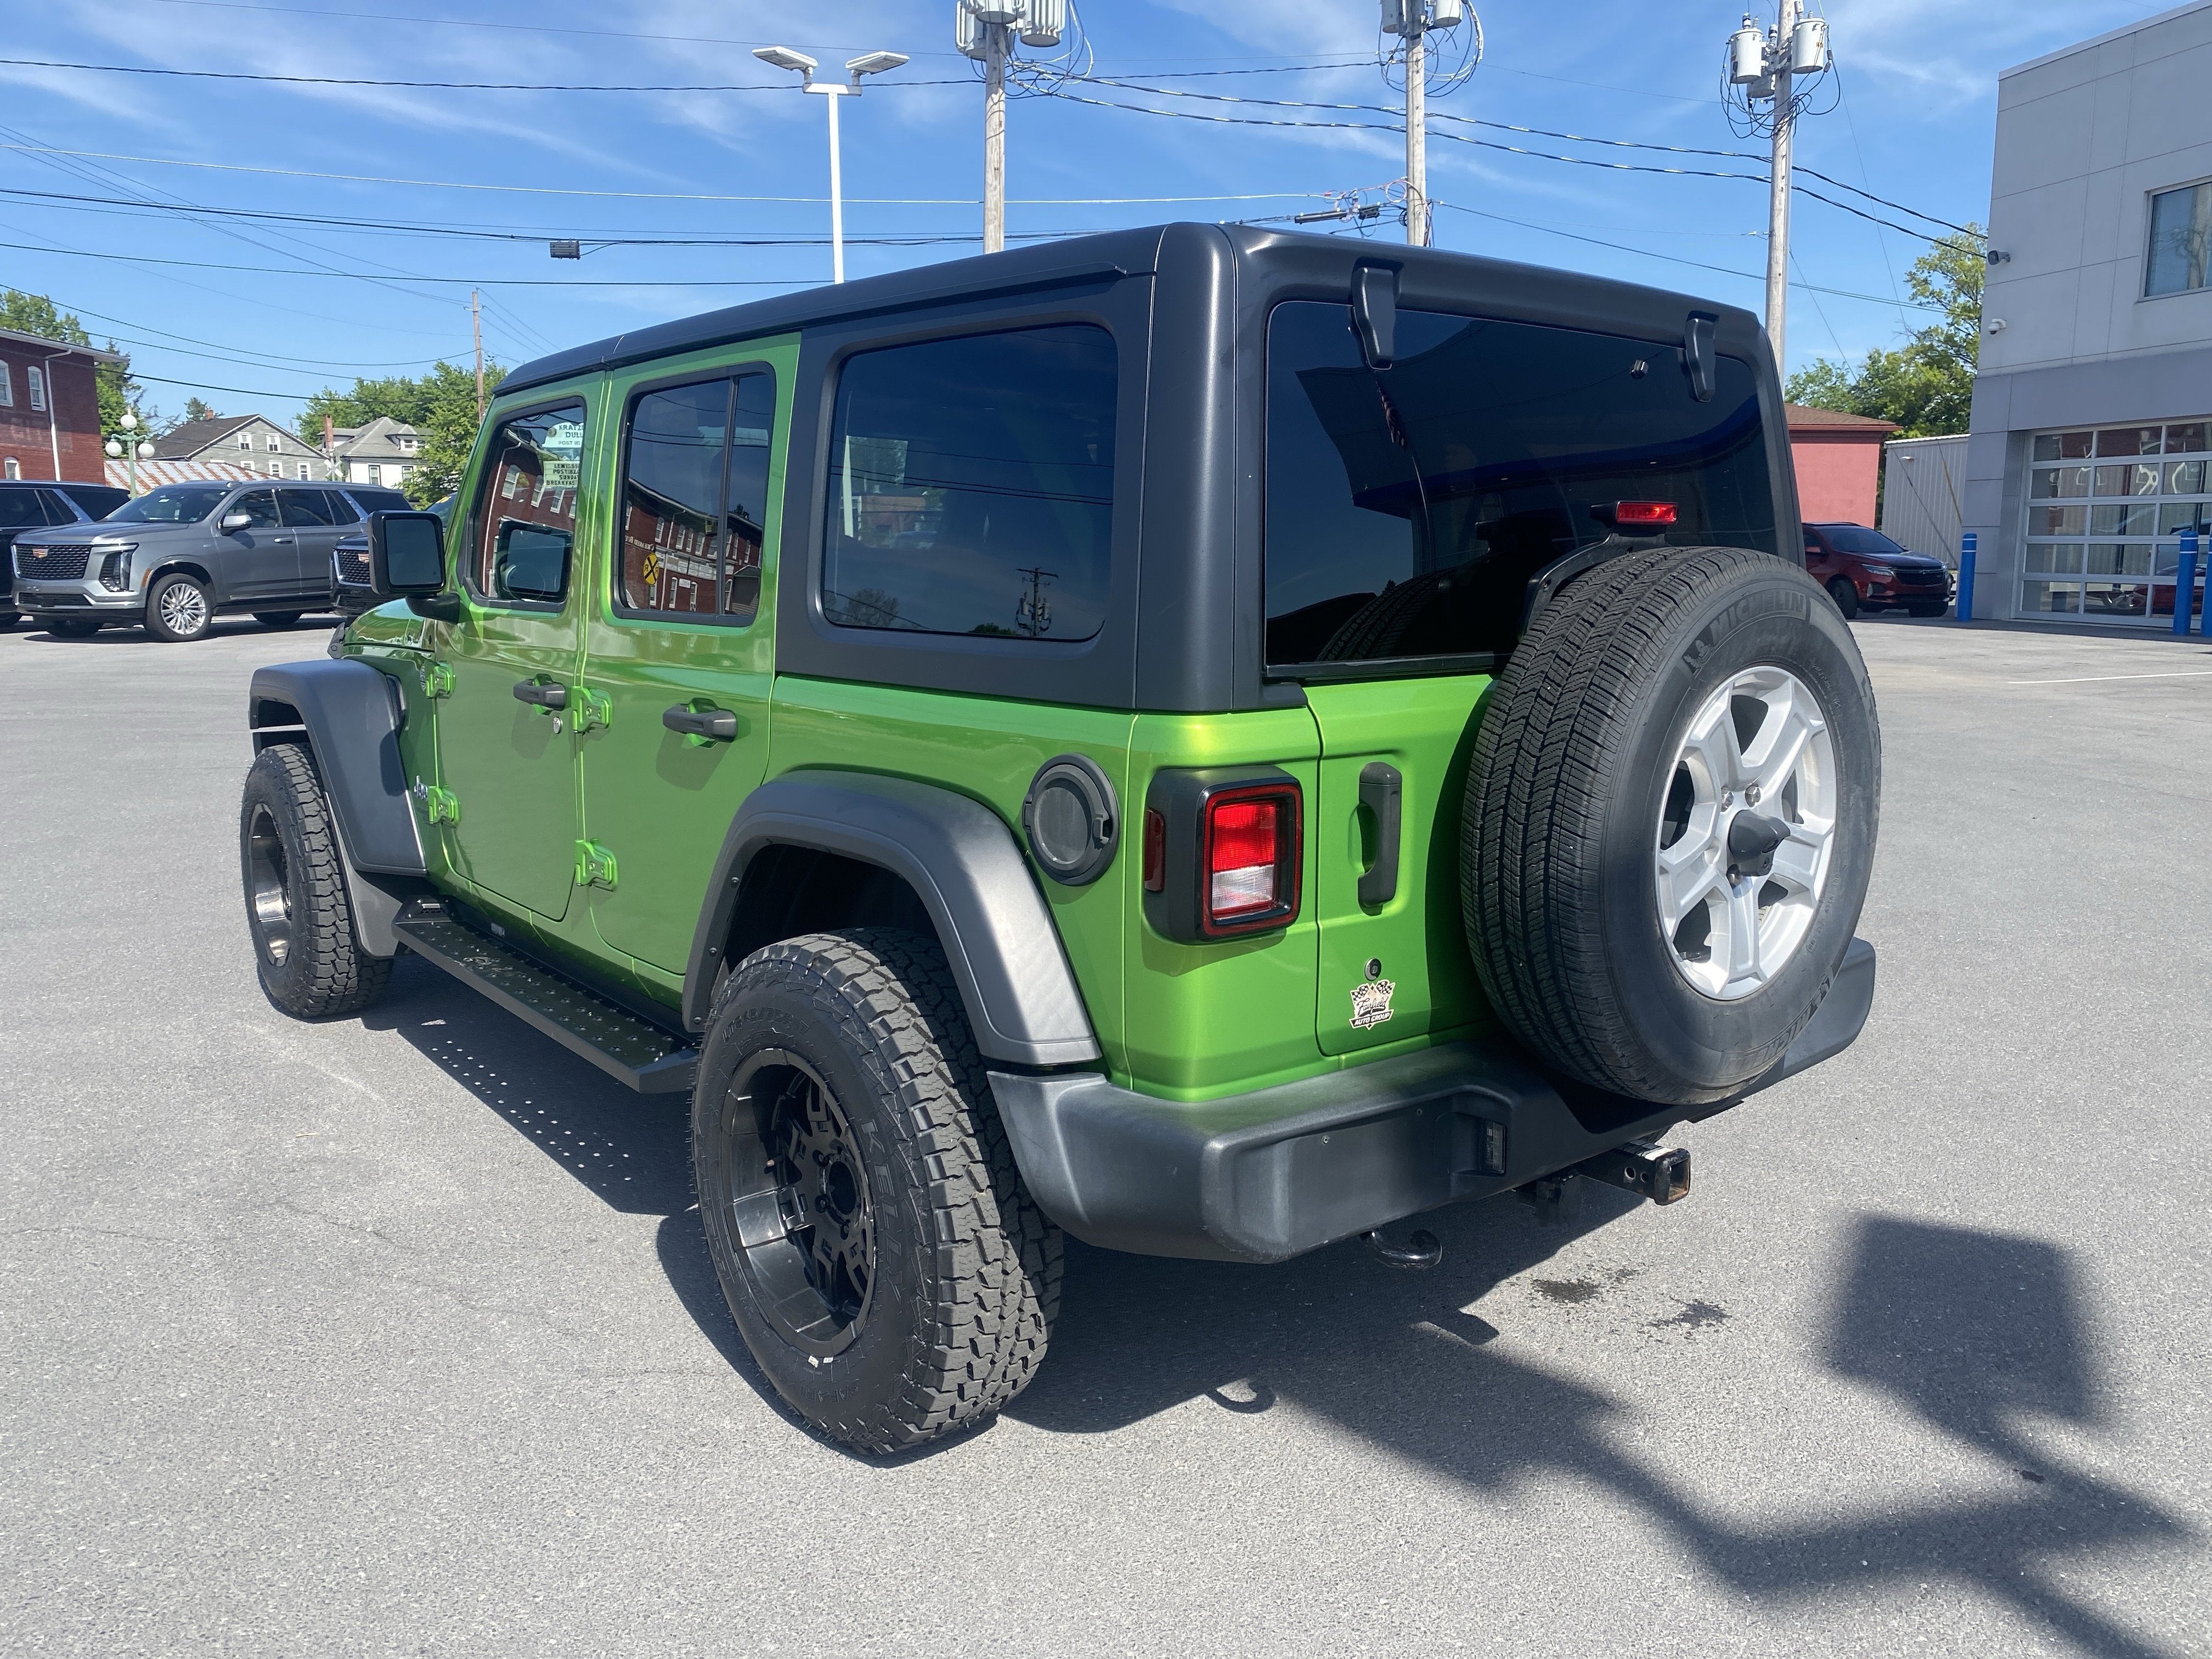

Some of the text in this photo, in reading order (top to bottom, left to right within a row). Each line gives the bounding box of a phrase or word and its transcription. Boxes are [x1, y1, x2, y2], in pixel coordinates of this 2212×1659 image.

[1710, 591, 1805, 645] MICHELIN
[1354, 1012, 1390, 1026] AUTO GROUP
[1356, 996, 1389, 1015] Fairfield
[861, 1119, 902, 1304] KELLY
